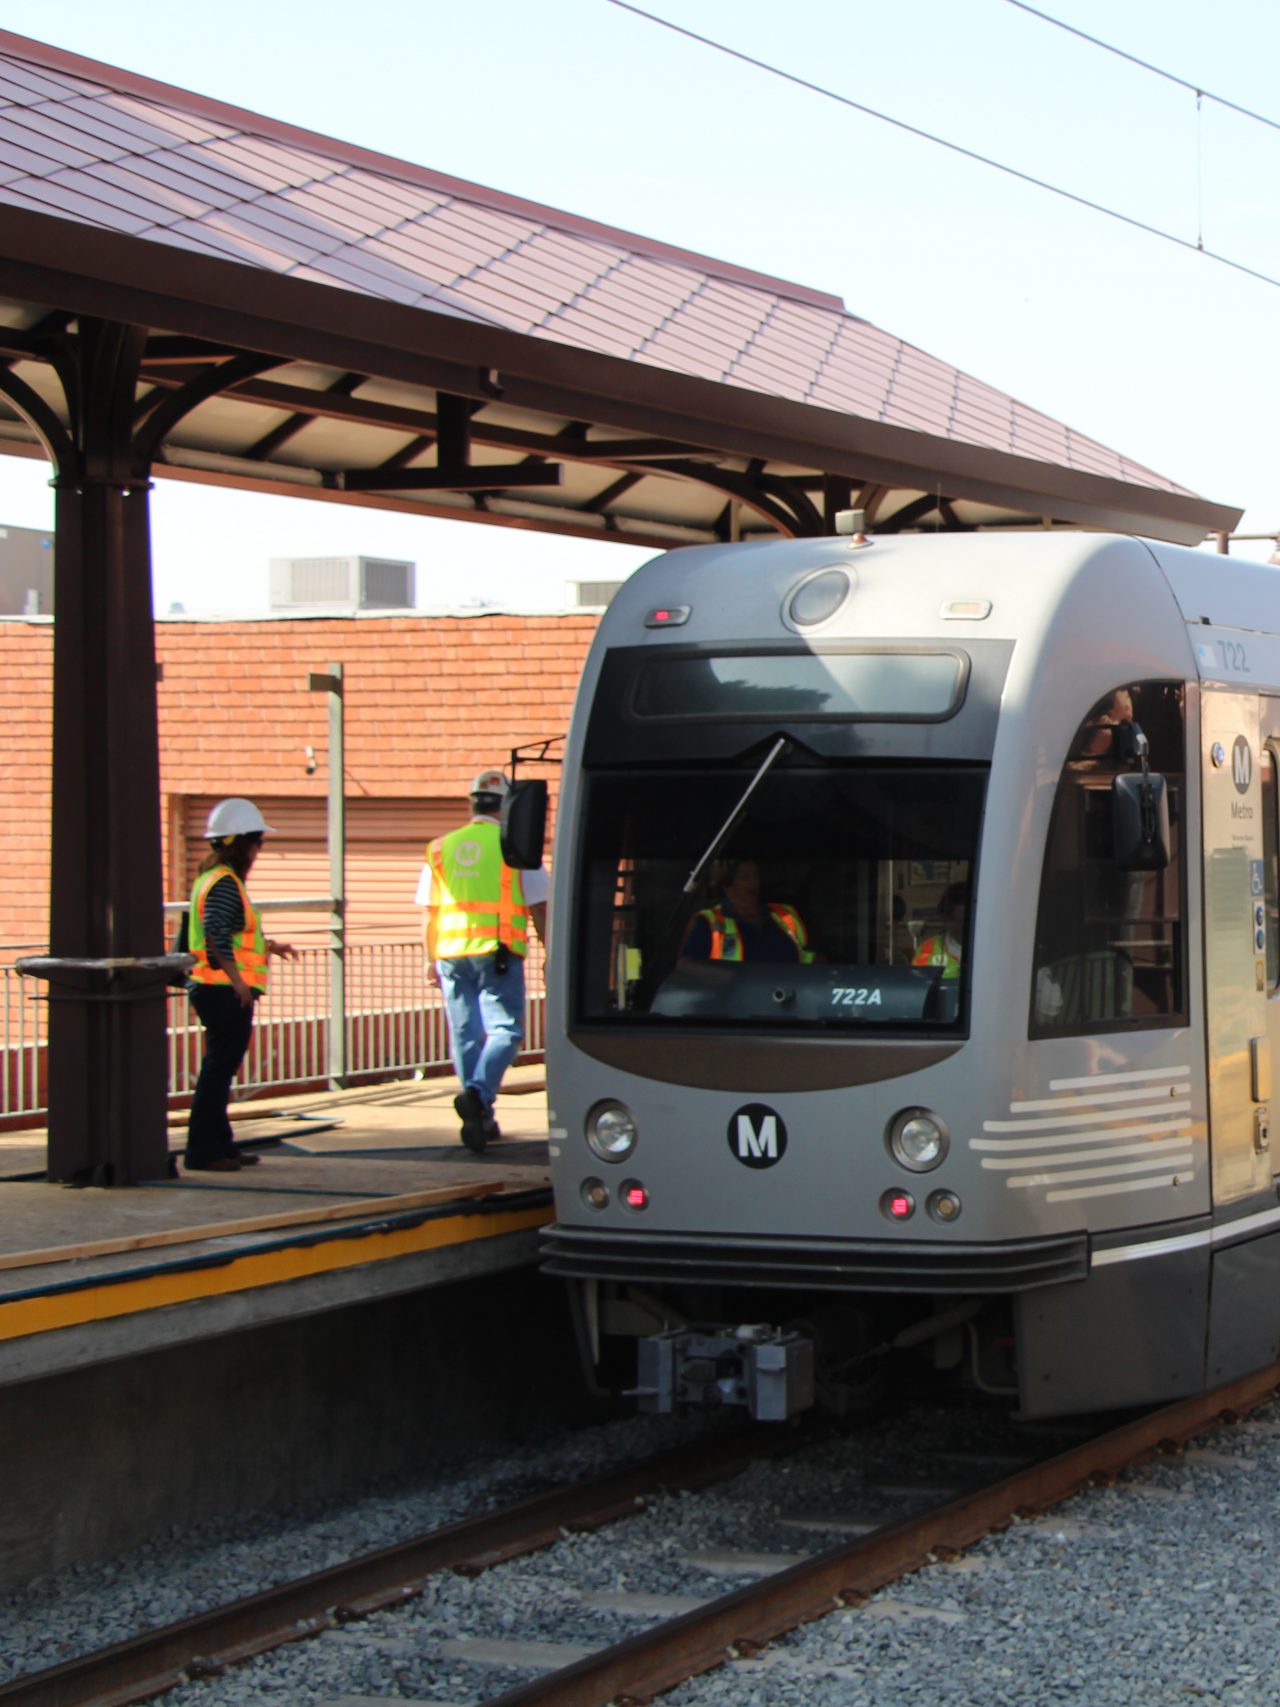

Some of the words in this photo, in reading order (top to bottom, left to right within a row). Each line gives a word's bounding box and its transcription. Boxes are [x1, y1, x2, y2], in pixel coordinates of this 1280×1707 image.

[1217, 640, 1250, 672] 722
[1234, 746, 1249, 785] M
[1231, 802, 1254, 819] Metro
[831, 988, 882, 1006] 722A
[737, 1114, 778, 1158] M
